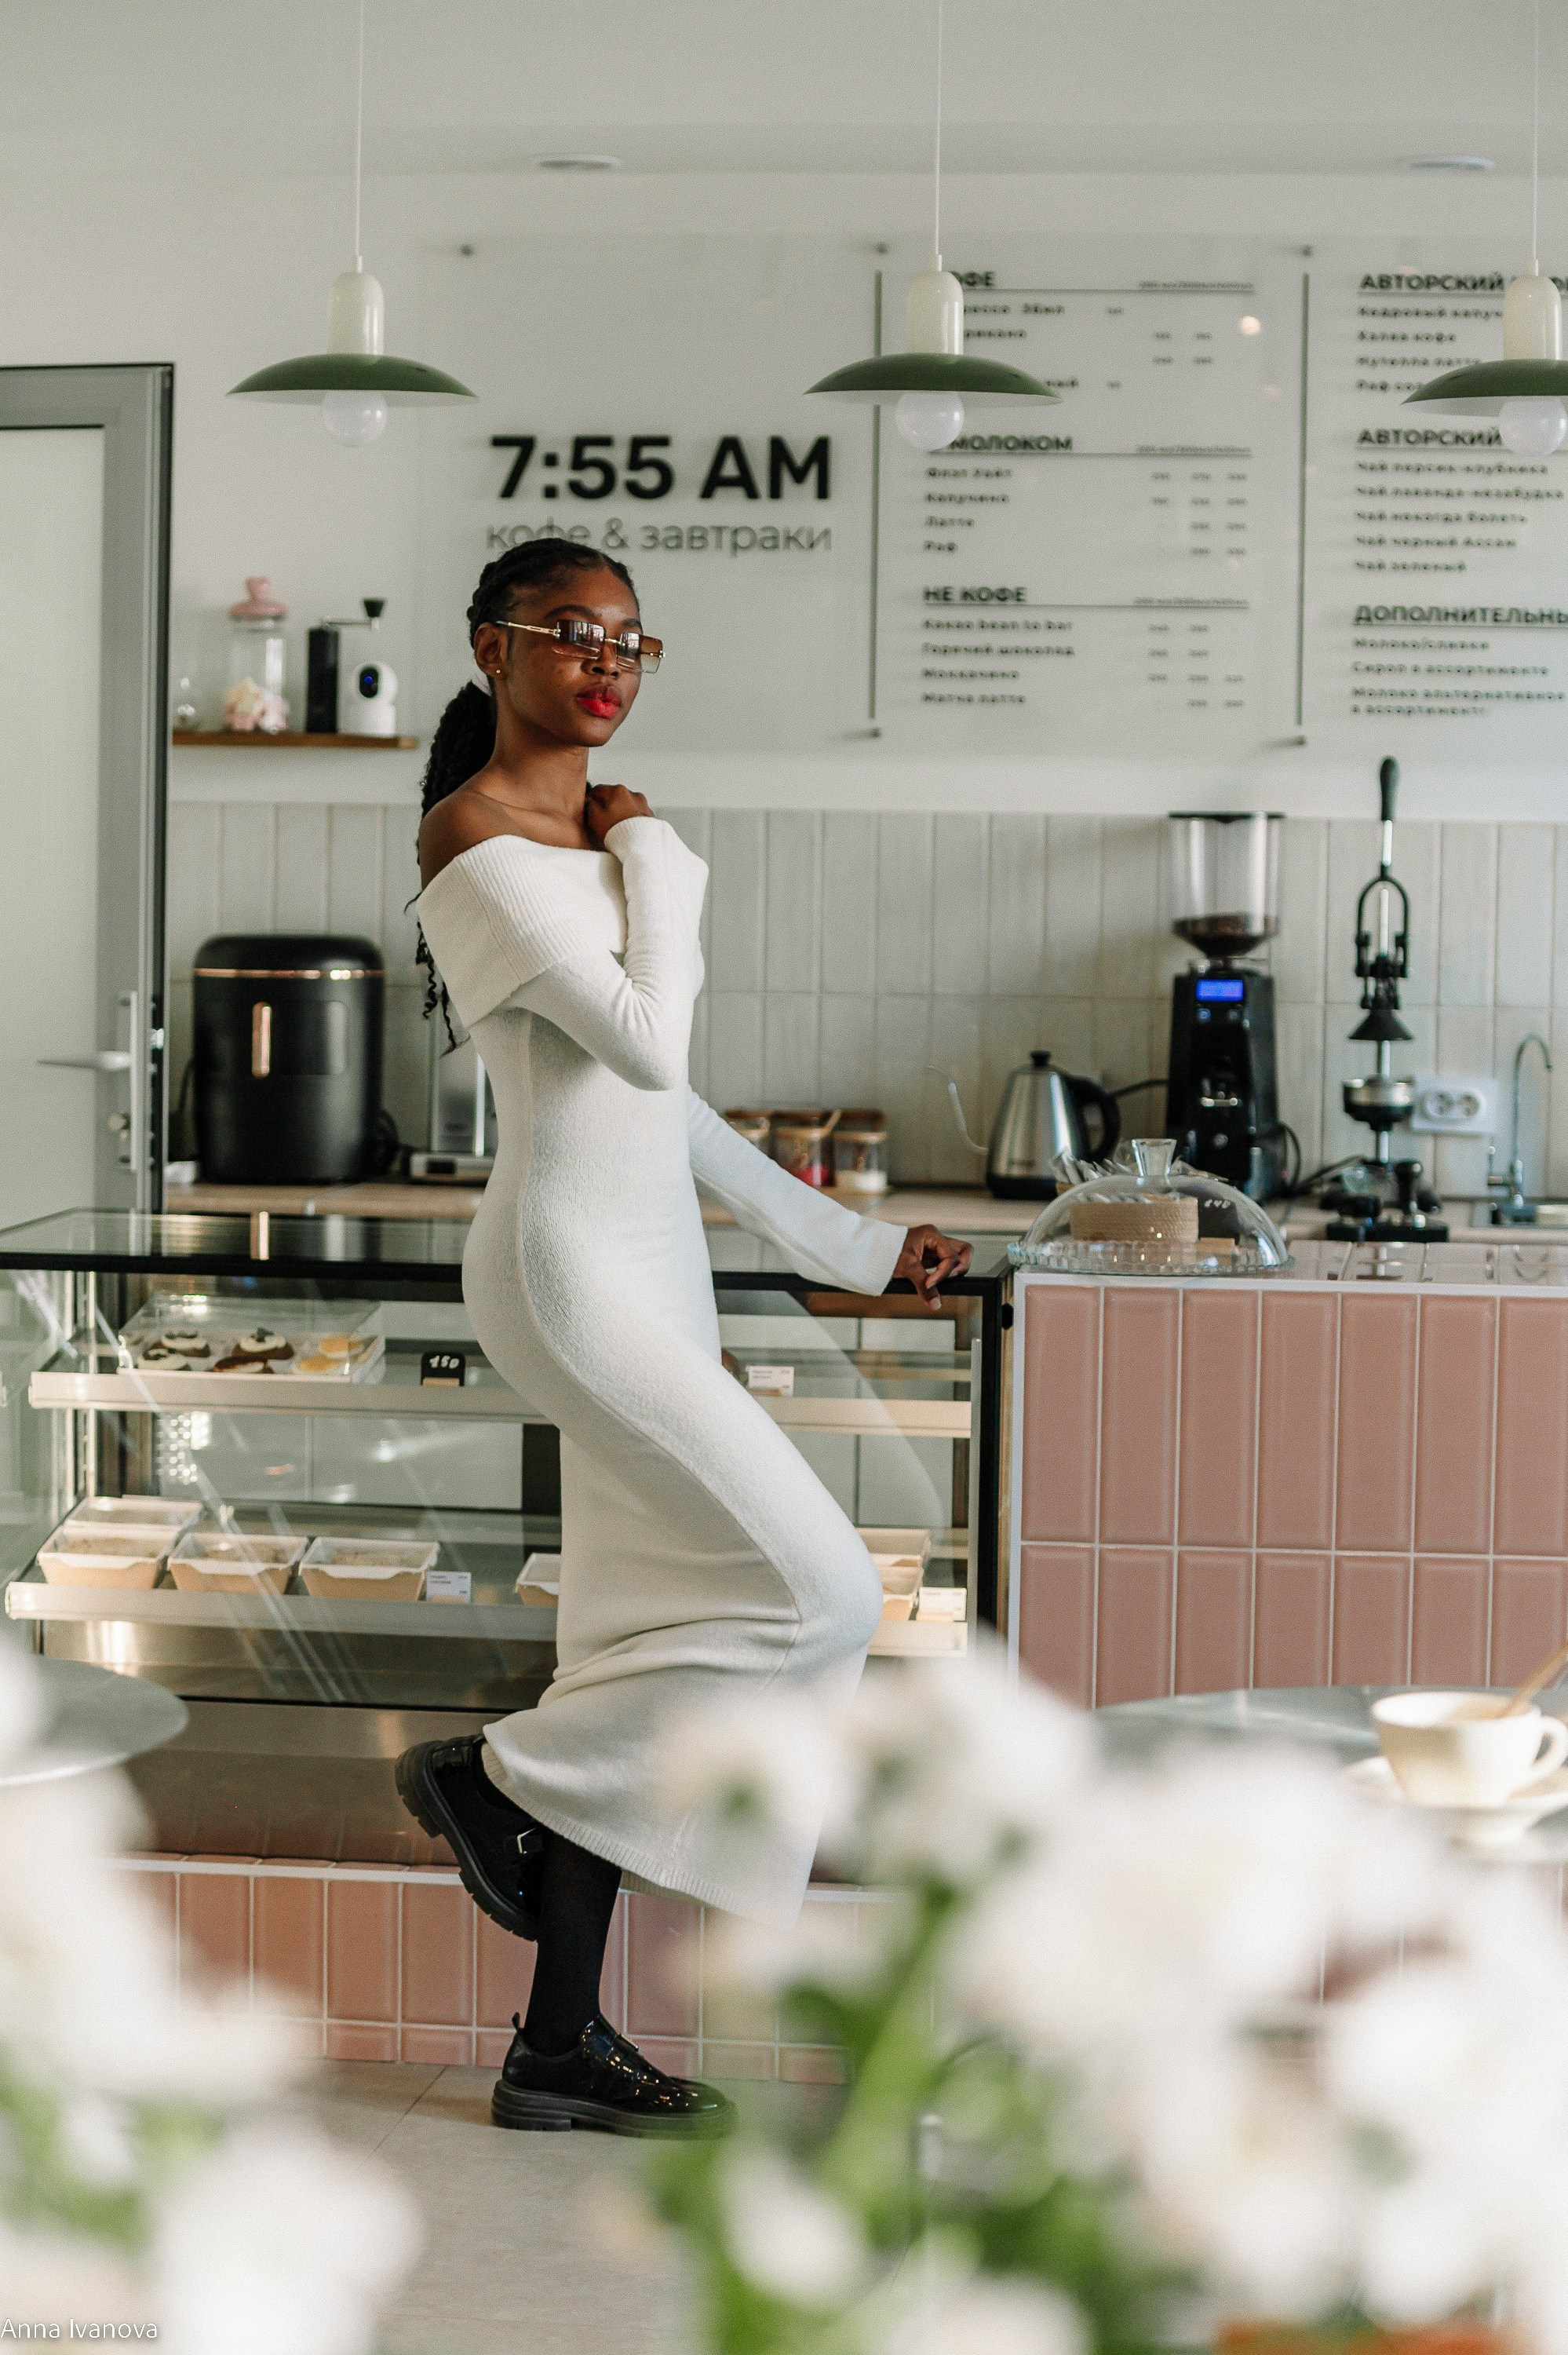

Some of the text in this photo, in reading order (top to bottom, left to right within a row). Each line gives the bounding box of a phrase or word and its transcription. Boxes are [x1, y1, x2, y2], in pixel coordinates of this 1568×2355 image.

[1360, 272, 1504, 290] АВТОРСКИЙ
[1358, 427, 1502, 446] АВТОРСКИЙ
[490, 435, 830, 501] 7:55 AM
[486, 517, 833, 557] кофе & завтраки
[924, 540, 958, 554] Раф
[923, 586, 1026, 603] НЕ КОФЕ
[429, 1355, 460, 1369] 150
